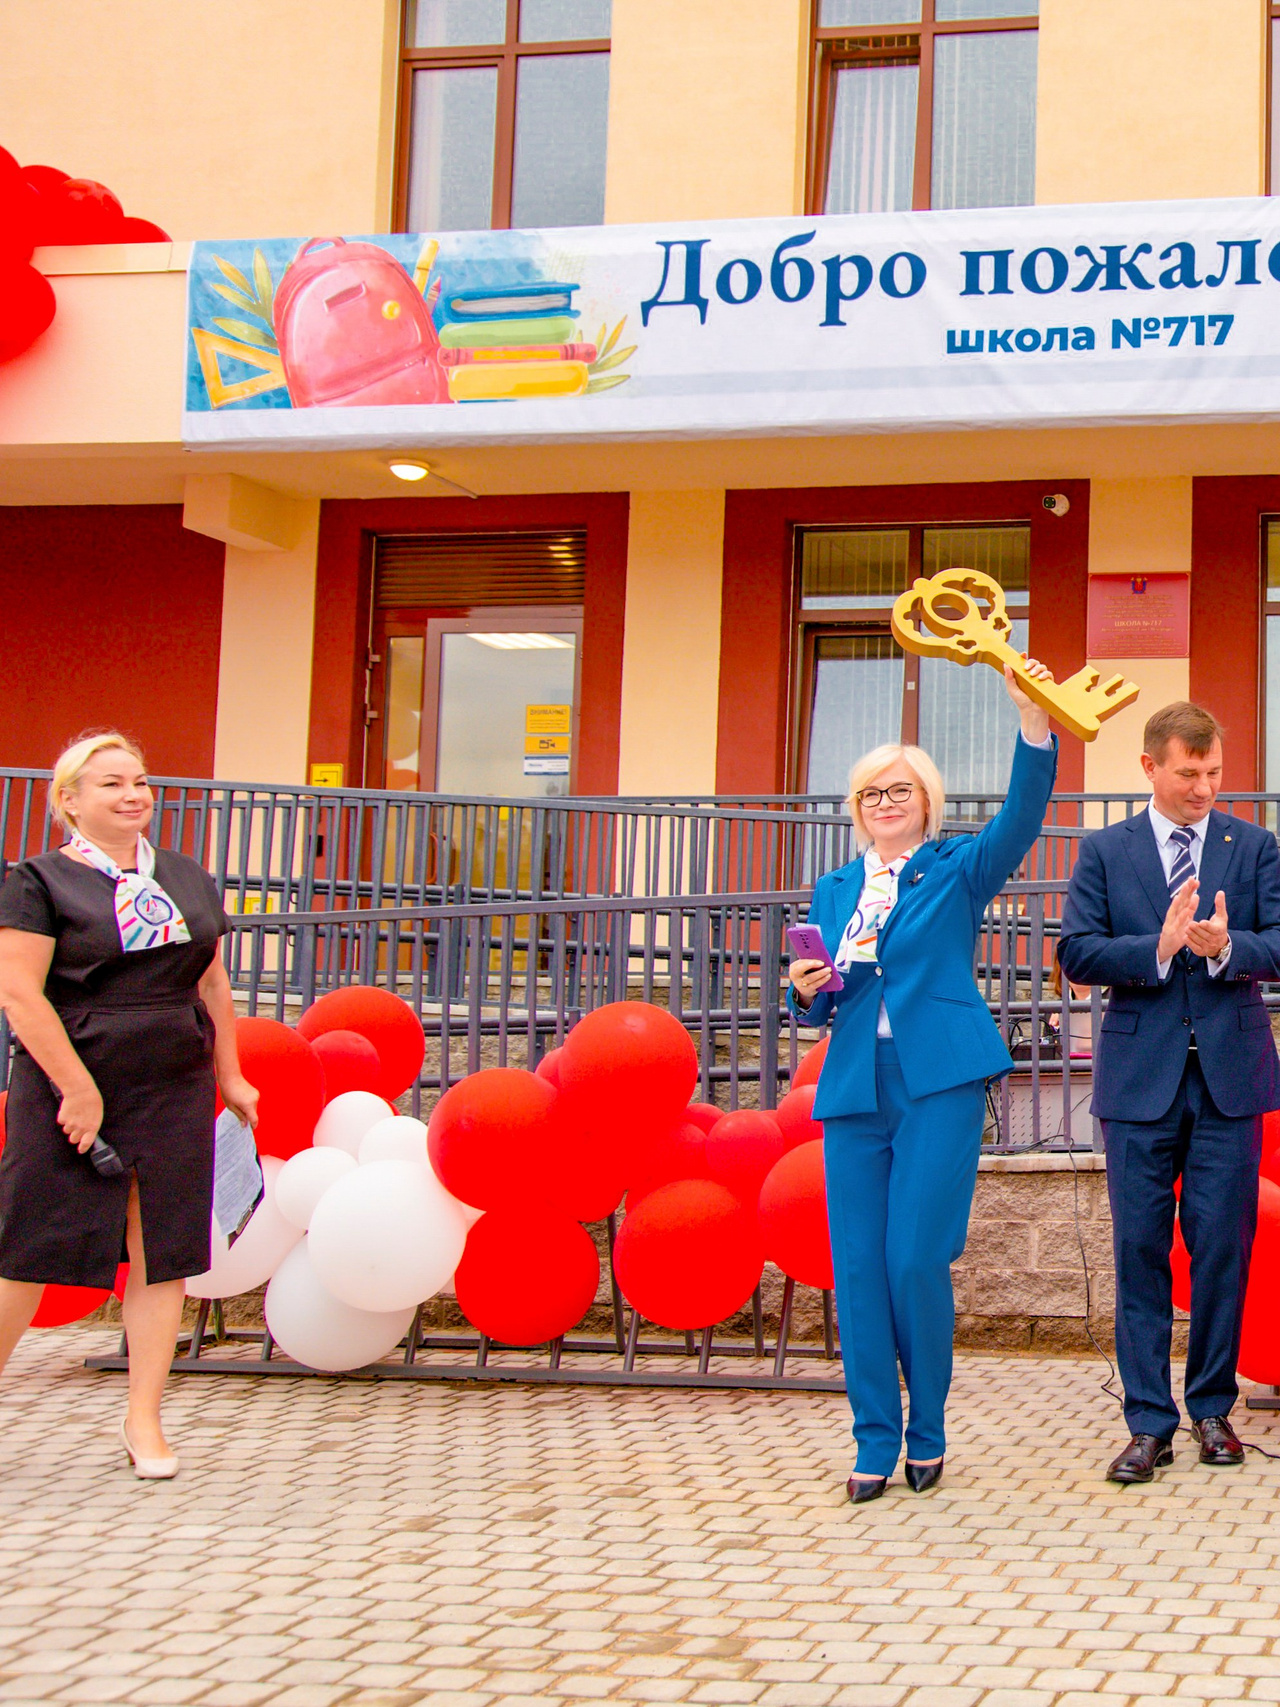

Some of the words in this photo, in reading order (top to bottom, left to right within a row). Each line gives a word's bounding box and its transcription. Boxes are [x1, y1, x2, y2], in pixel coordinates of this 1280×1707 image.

[640, 230, 928, 328] Добро
[945, 325, 1096, 355] школа
[1111, 313, 1235, 350] №717
[1114, 619, 1141, 627] ШКОЛА
